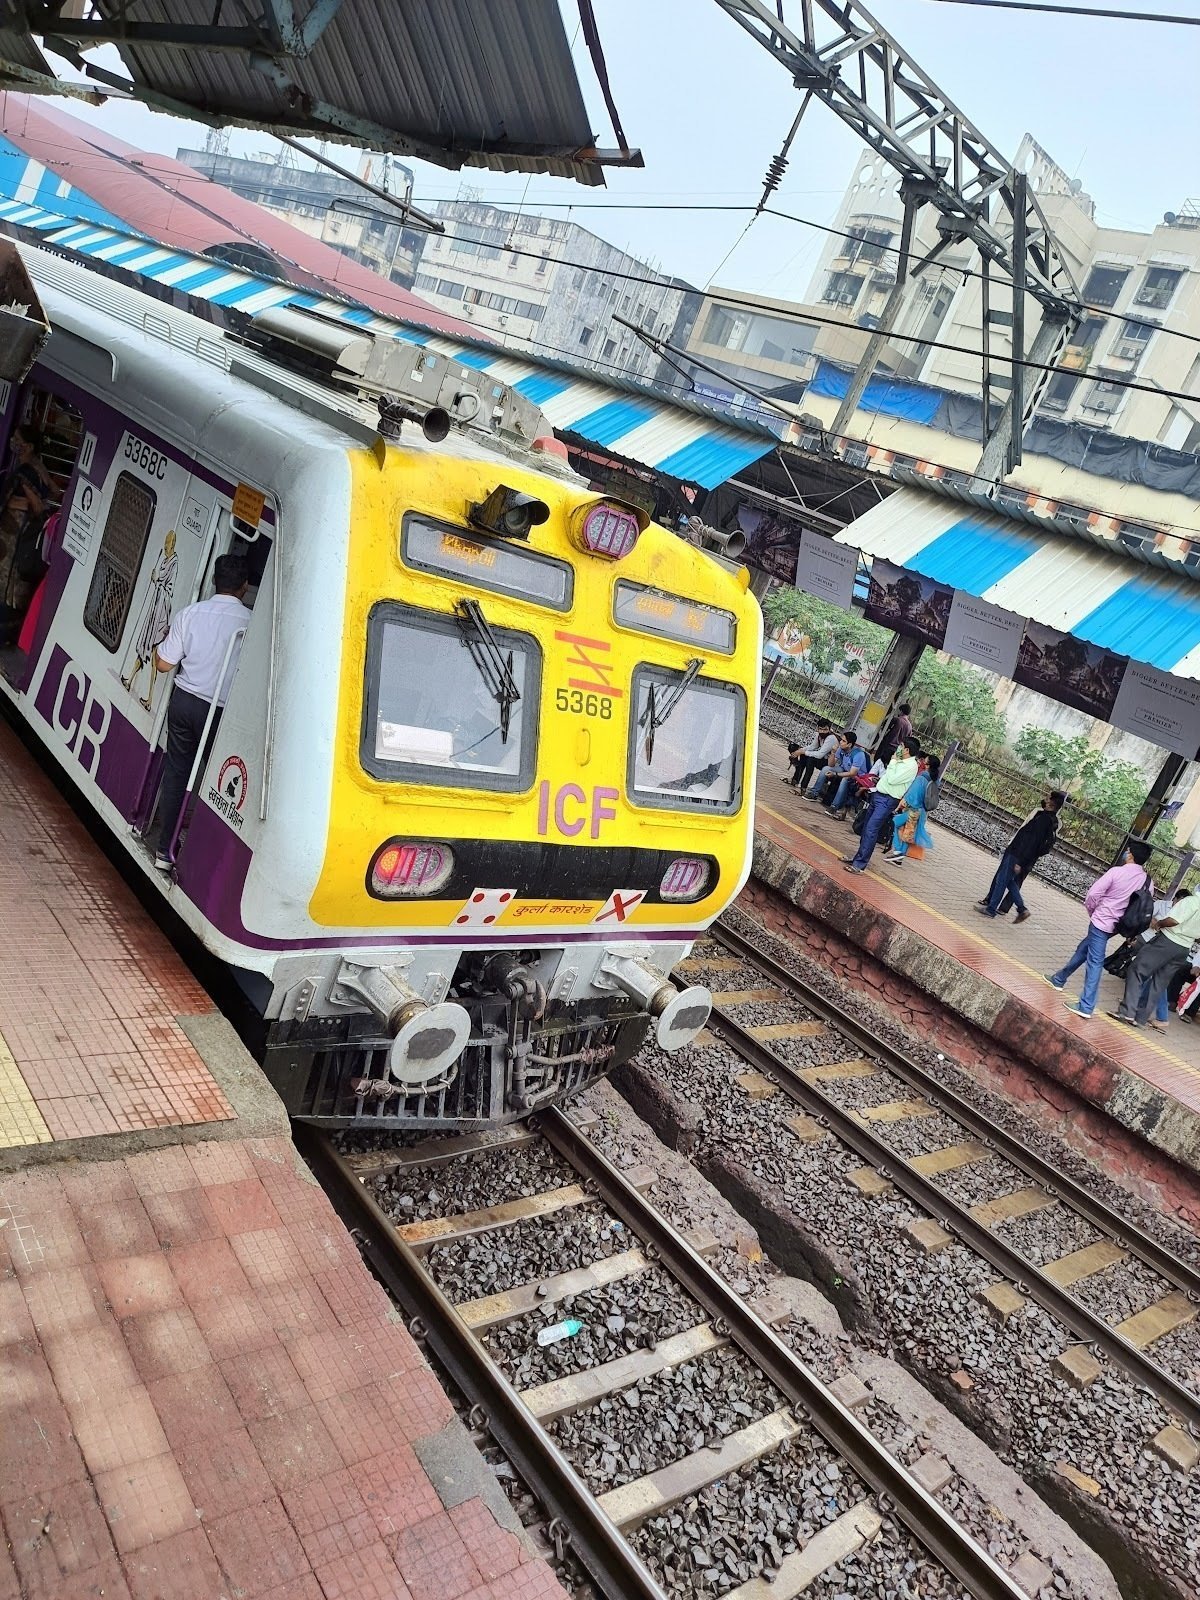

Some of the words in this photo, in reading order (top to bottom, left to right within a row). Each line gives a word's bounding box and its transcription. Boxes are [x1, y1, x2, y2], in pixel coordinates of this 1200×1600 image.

[124, 434, 168, 481] 5368C
[969, 641, 992, 653] PREMIER
[556, 688, 612, 720] 5368
[1143, 714, 1172, 729] PREMIER
[537, 780, 620, 839] ICF
[513, 903, 546, 917] कुर्ला
[549, 903, 595, 914] कारशेड
